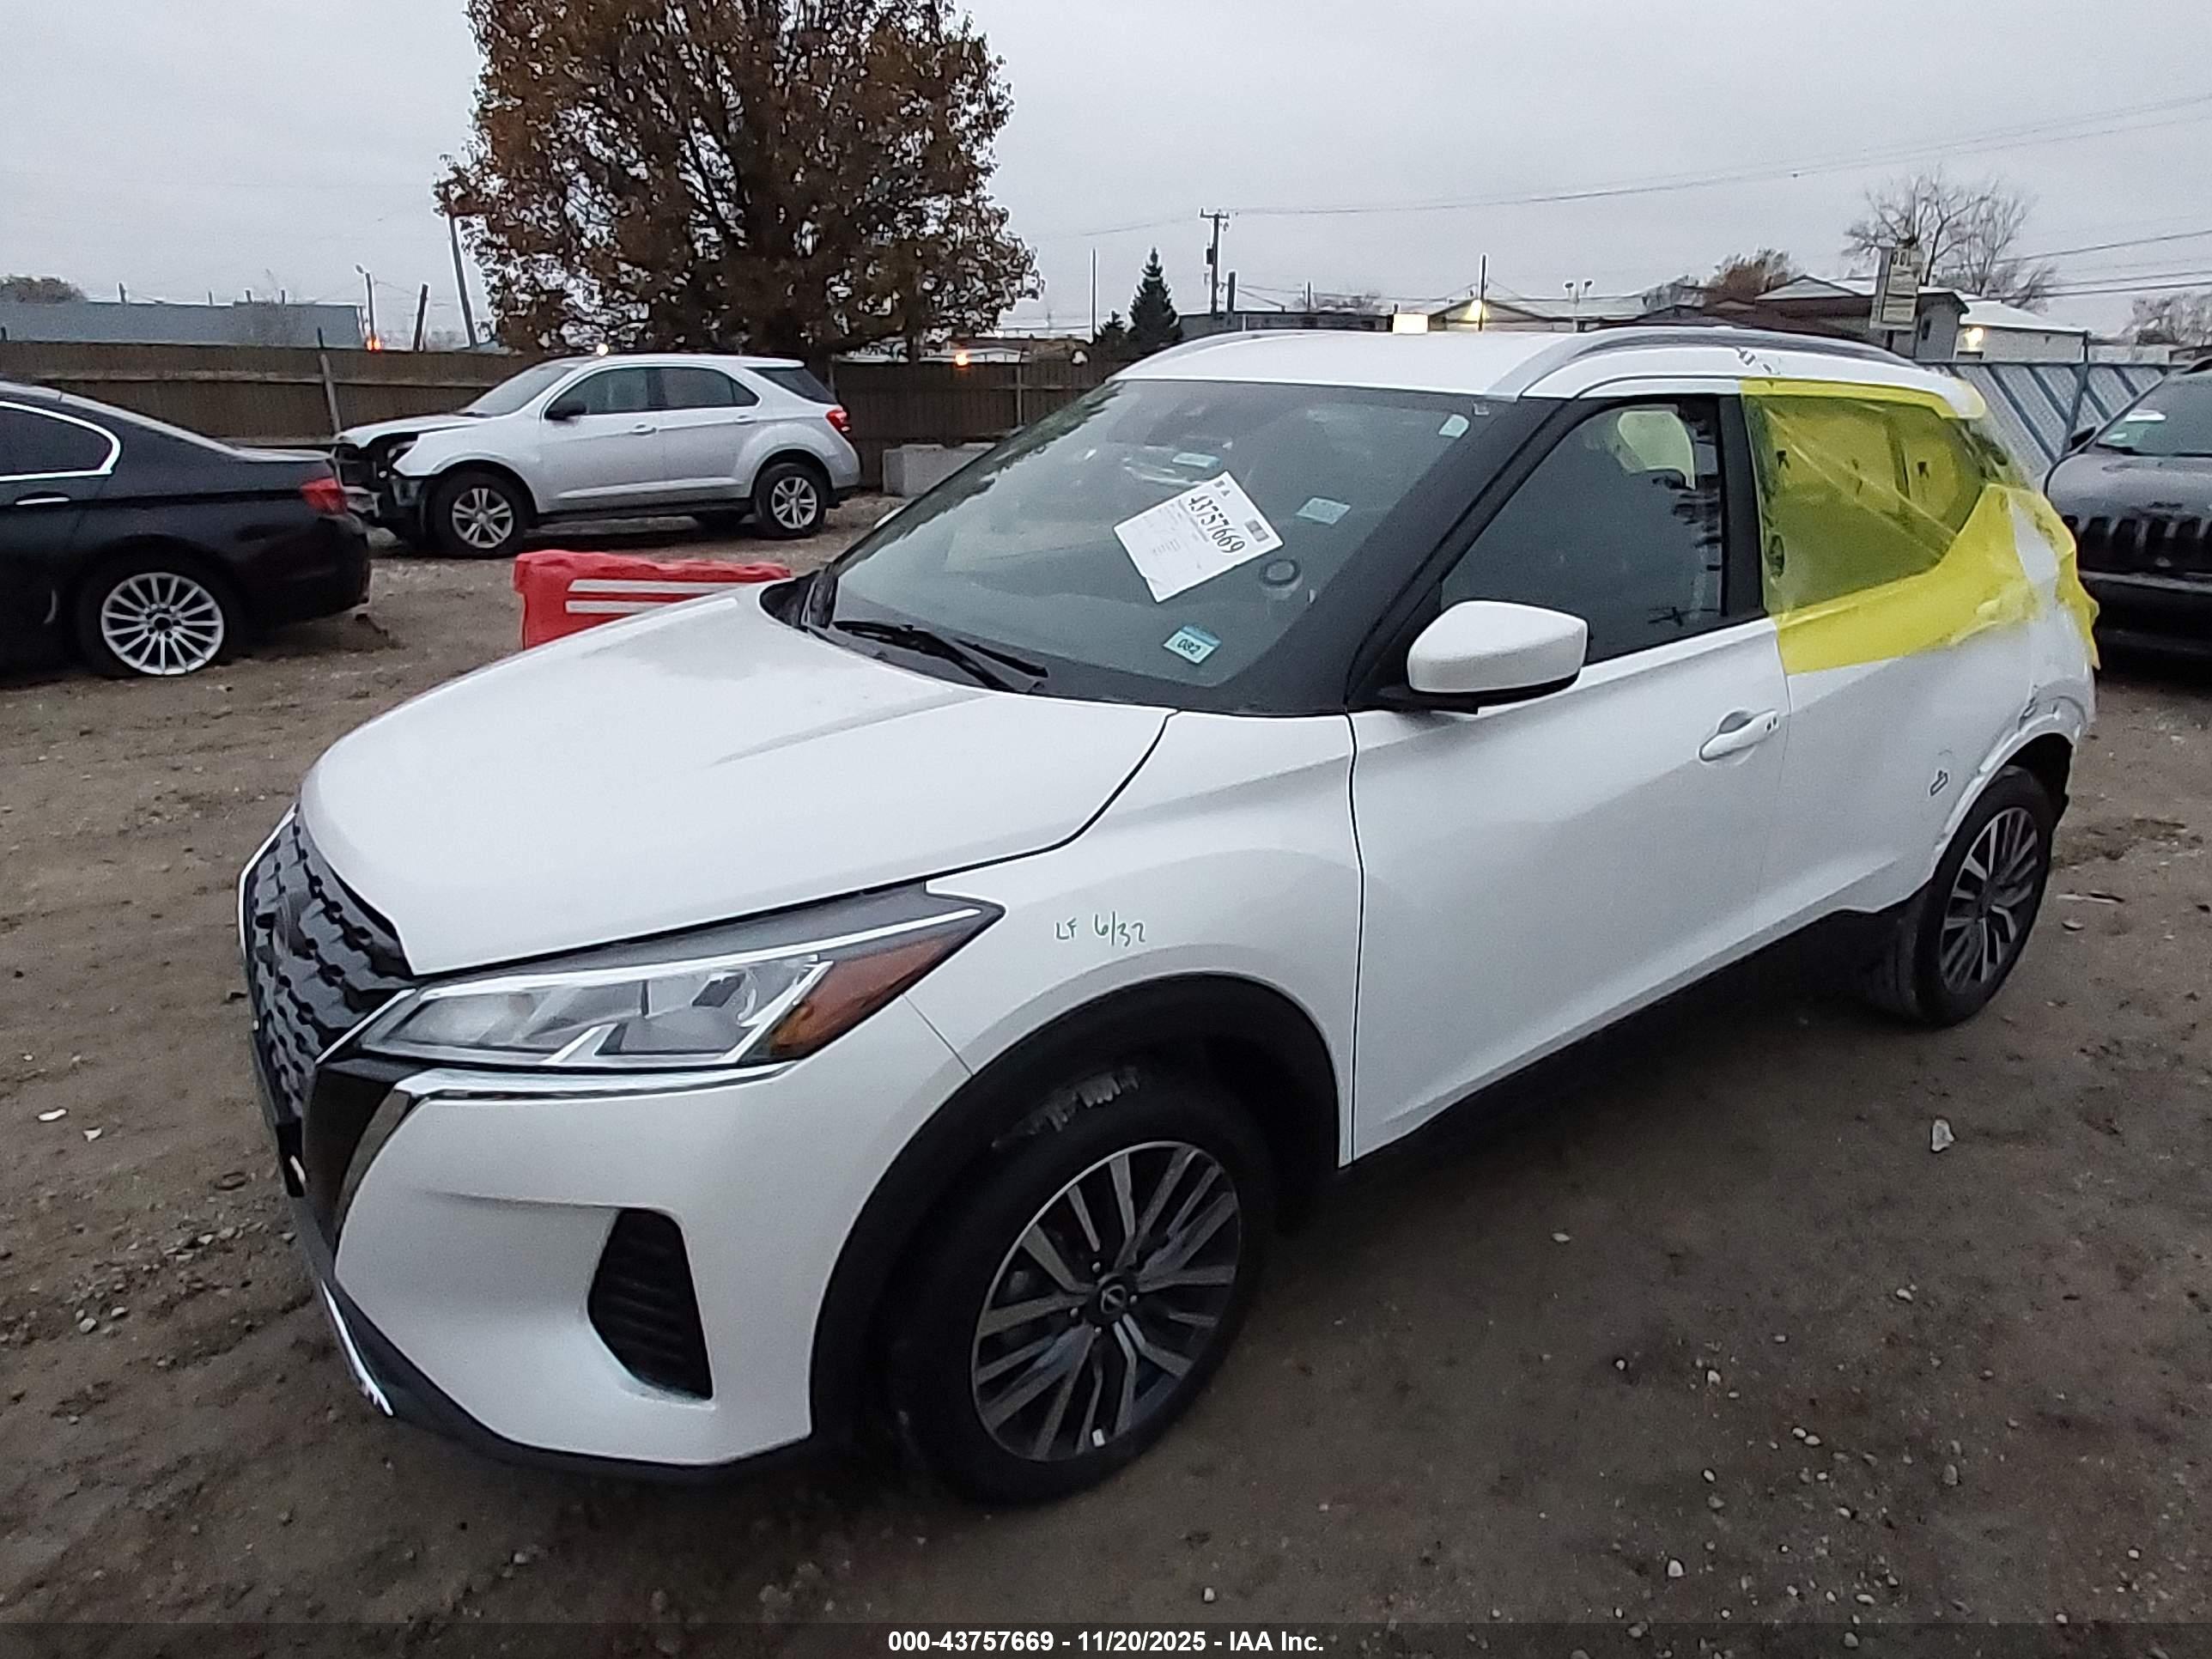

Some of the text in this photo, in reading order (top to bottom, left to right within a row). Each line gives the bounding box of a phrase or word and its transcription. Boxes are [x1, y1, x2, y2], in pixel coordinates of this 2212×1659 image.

[1188, 495, 1246, 554] 43757669
[1055, 910, 1146, 947] LF 6/32
